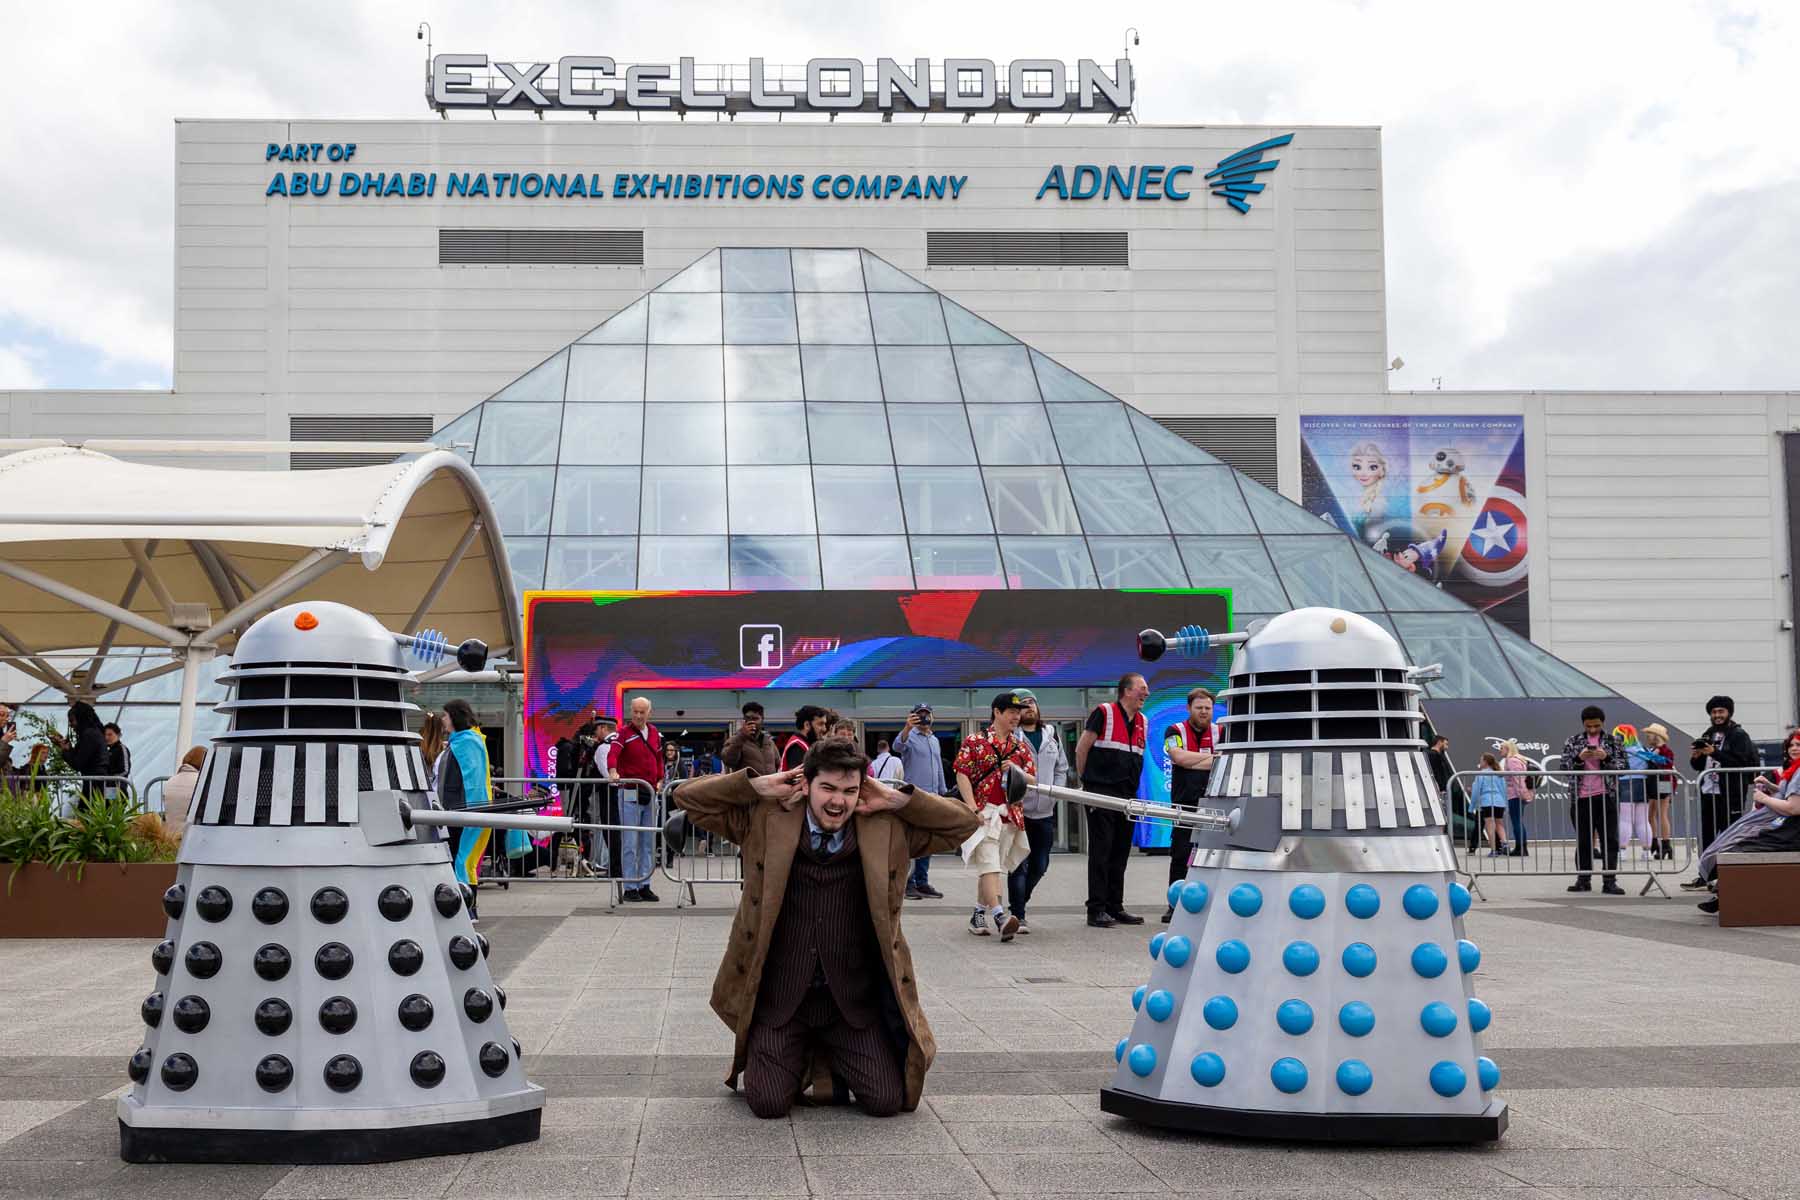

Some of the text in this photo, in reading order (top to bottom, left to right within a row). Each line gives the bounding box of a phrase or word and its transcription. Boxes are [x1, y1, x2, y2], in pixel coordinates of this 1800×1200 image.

[749, 56, 1132, 111] LONDON
[266, 143, 357, 162] PART OF
[266, 172, 969, 200] ABU DHABI NATIONAL EXHIBITIONS COMPANY
[1035, 164, 1195, 201] ADNEC
